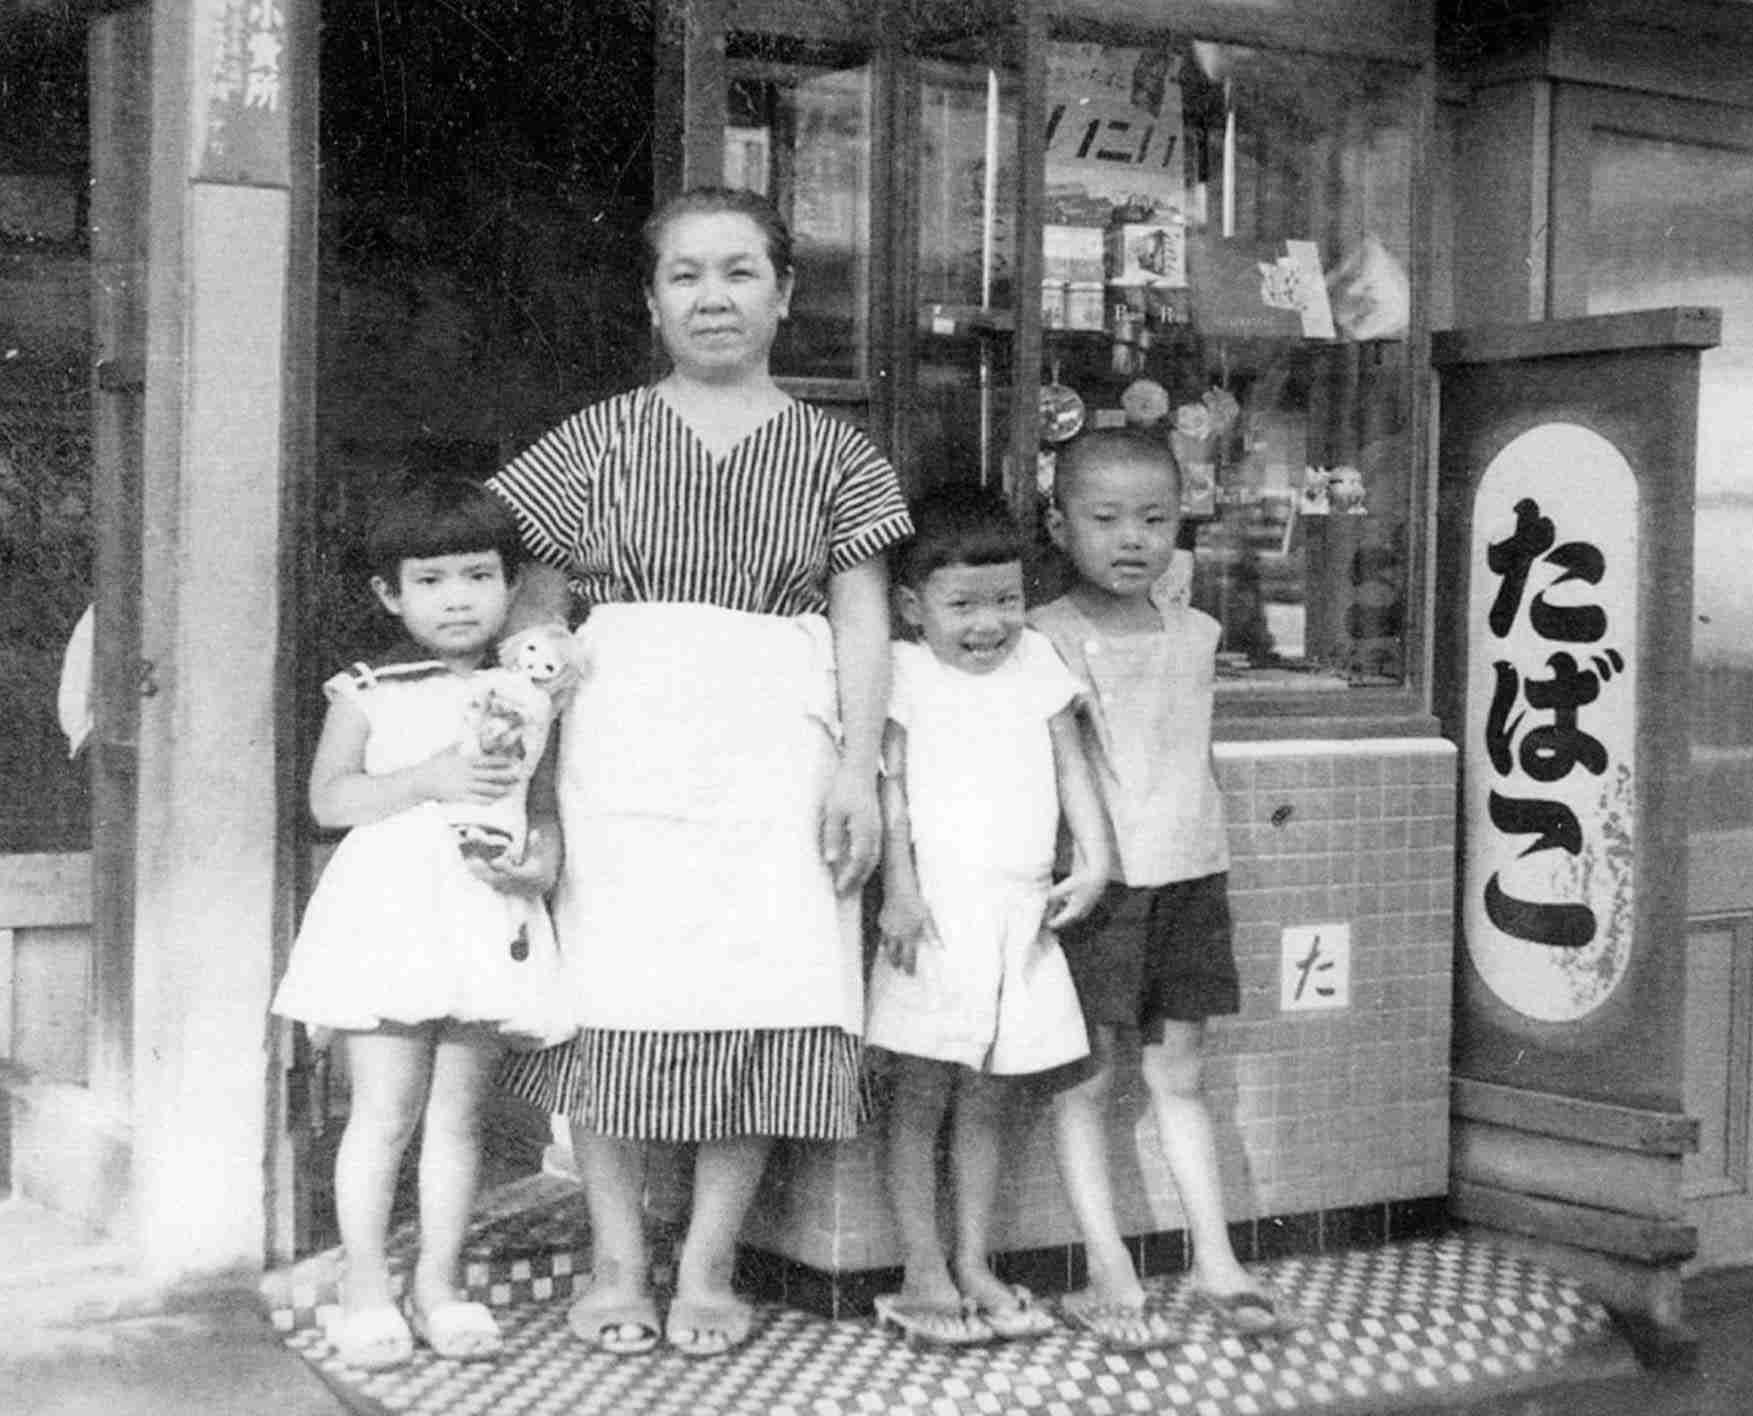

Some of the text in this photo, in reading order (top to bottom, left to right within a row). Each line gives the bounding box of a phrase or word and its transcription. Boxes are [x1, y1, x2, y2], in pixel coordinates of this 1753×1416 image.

[1484, 497, 1625, 948] たばこ
[1295, 935, 1336, 1001] た
